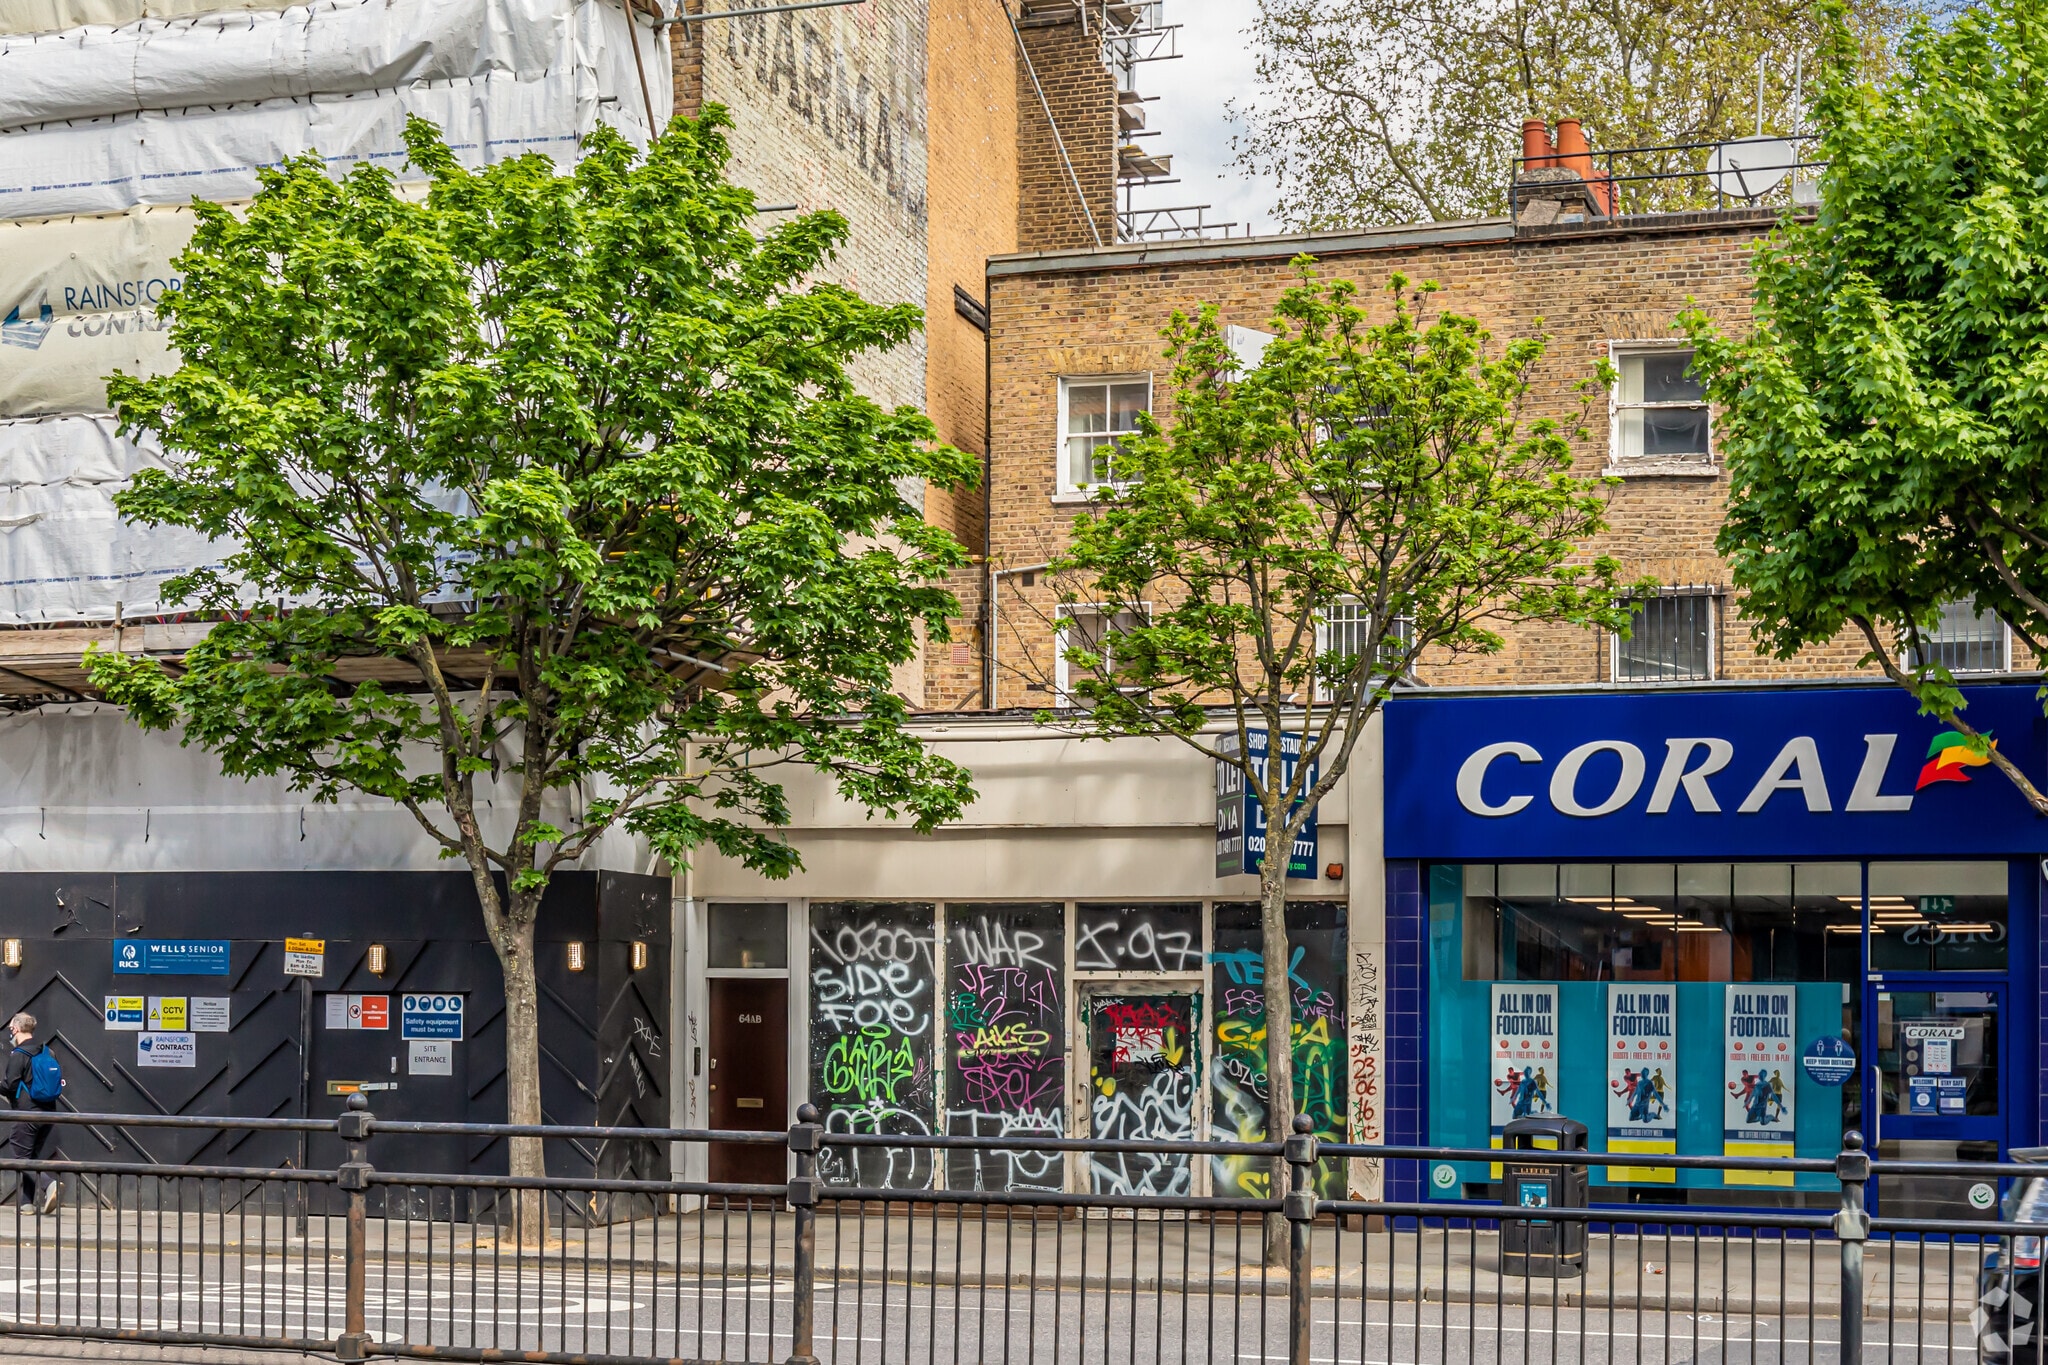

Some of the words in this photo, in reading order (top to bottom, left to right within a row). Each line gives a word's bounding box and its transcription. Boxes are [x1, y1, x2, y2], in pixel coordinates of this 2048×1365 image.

[65, 278, 199, 310] RAINSFOR
[1248, 732, 1267, 750] SHOP
[1456, 733, 1914, 817] CORAL
[1248, 836, 1266, 852] 020
[150, 945, 186, 953] WELLS
[188, 945, 224, 953] SENIOR
[957, 915, 1057, 972] WAR
[163, 1006, 184, 1014] CCTV
[1499, 994, 1519, 1013] ALL
[1521, 994, 1534, 1013] IN
[1536, 994, 1552, 1013] ON
[1616, 994, 1636, 1013] ALL
[1638, 994, 1651, 1013] IN
[1653, 994, 1670, 1014] ON
[1733, 994, 1754, 1014] ALL
[1756, 995, 1769, 1015] IN
[1771, 995, 1788, 1015] ON
[426, 1018, 459, 1026] equipment
[738, 1014, 762, 1024] 64AB
[1496, 1015, 1553, 1035] FOOTBALL
[1613, 1015, 1671, 1036] FOOTBALL
[1730, 1016, 1790, 1038] FOOTBALL
[1908, 1028, 1956, 1038] CORAL
[155, 1043, 193, 1051] CONTRACTS
